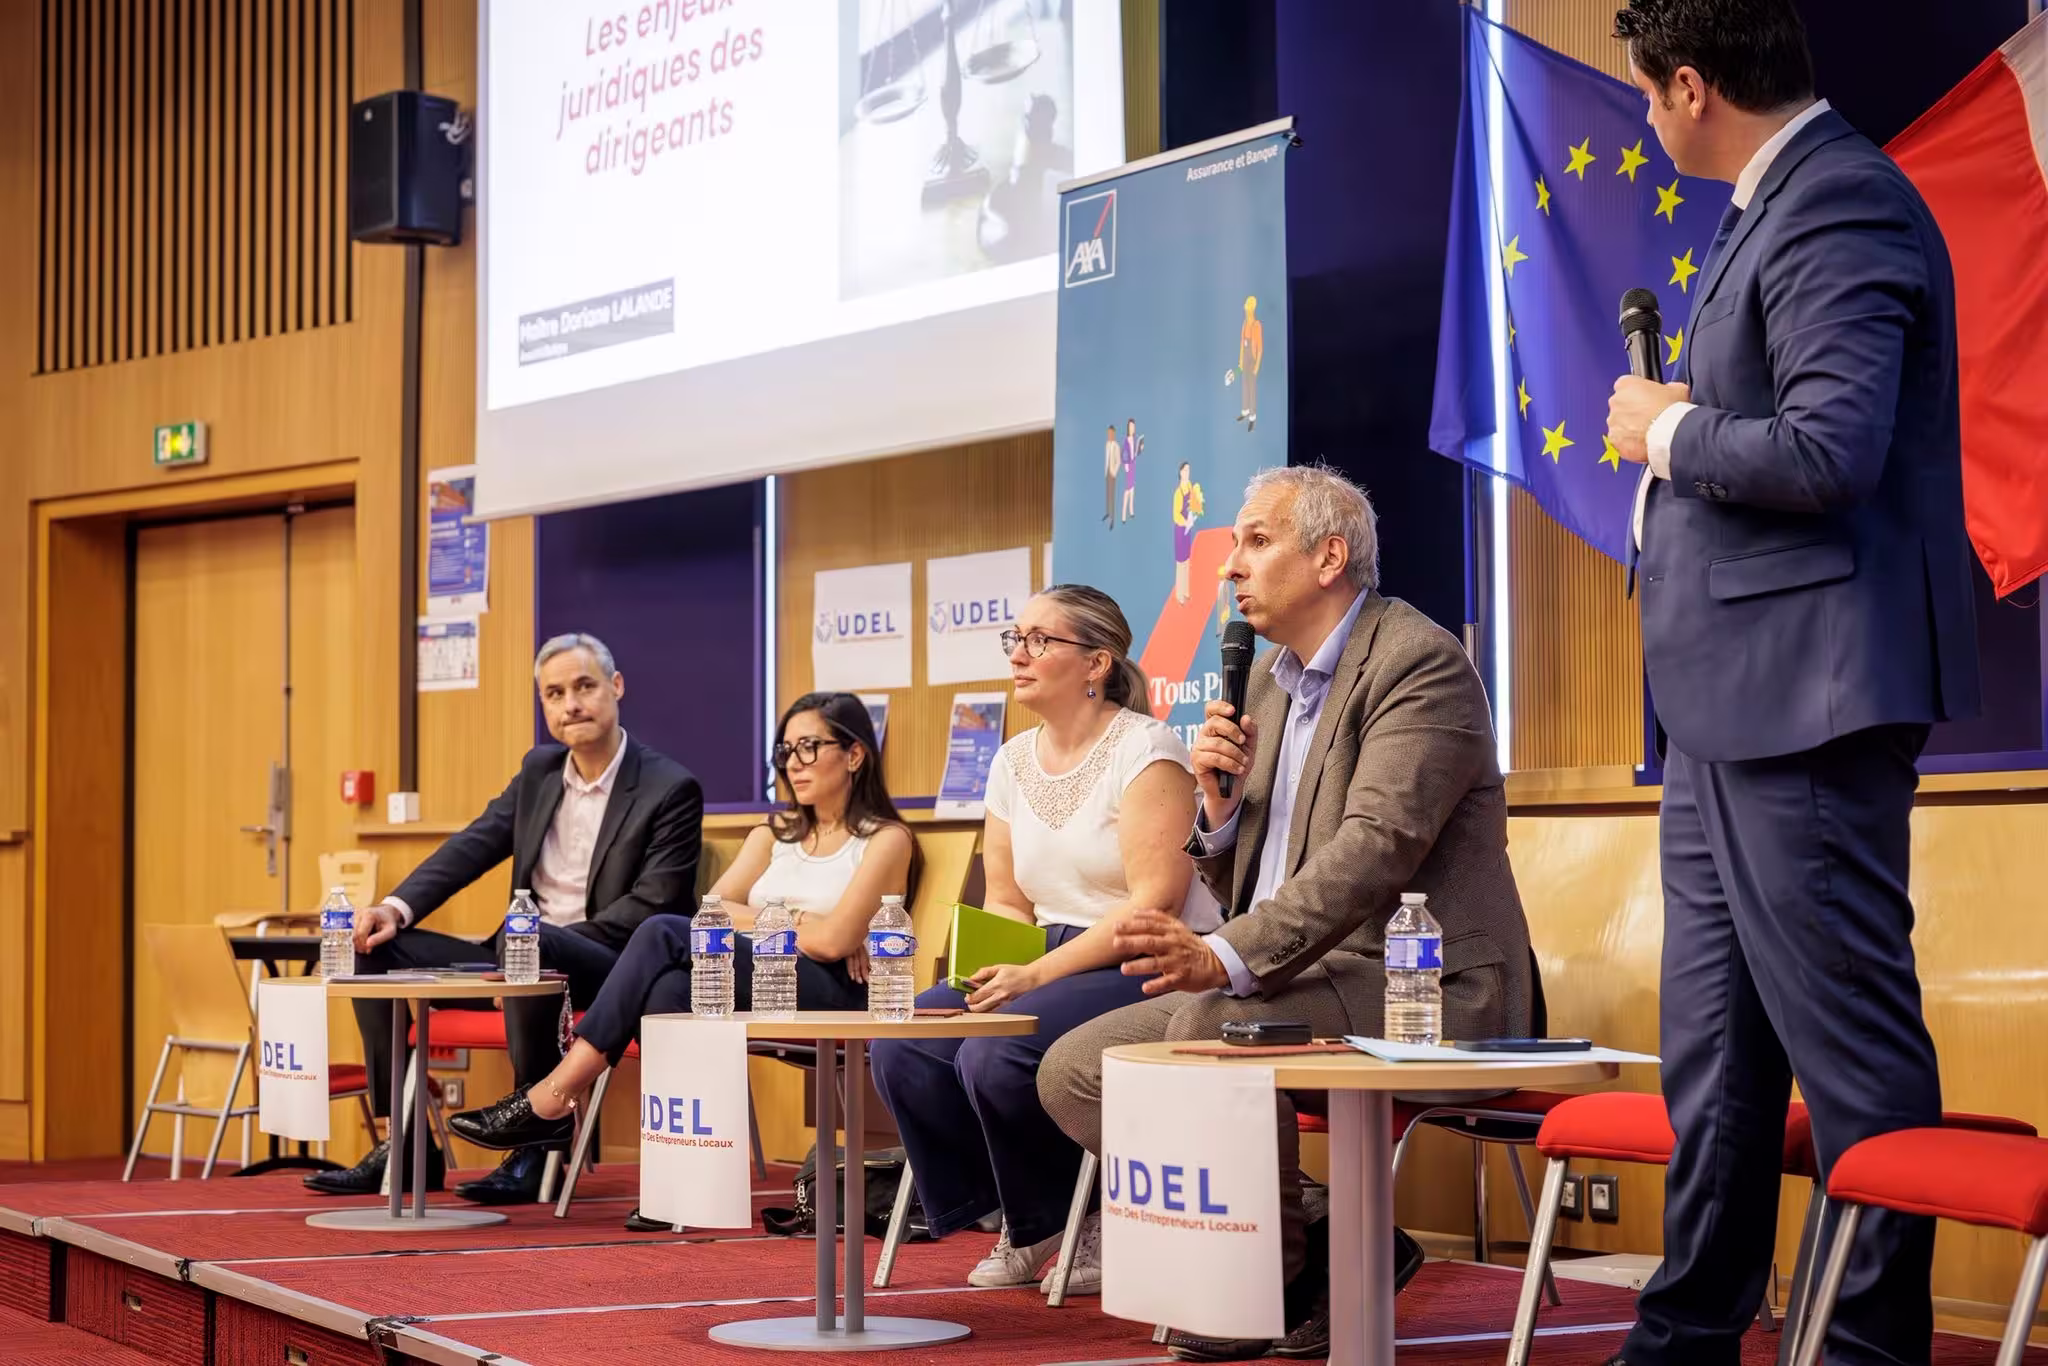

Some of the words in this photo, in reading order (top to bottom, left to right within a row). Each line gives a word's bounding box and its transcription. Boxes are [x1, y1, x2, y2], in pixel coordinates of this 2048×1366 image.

[585, 16, 627, 57] Les
[556, 48, 701, 141] juridiques
[710, 27, 763, 75] des
[585, 97, 734, 176] dirigeants
[1186, 158, 1234, 182] Assurance
[1235, 155, 1246, 169] et
[1246, 144, 1278, 163] Banque
[1066, 238, 1107, 277] AXA
[612, 286, 673, 322] LALANDE
[837, 611, 896, 636] UDEL
[952, 598, 1015, 626] UDEL
[1151, 676, 1200, 706] Tous
[259, 1040, 303, 1071] DEL
[656, 1134, 697, 1146] Entrepreneurs
[698, 1138, 734, 1148] Locaux
[1107, 1153, 1228, 1215] UDEL
[1124, 1207, 1138, 1220] Des
[1140, 1210, 1206, 1231] Entrepreneurs
[1208, 1220, 1259, 1233] Locaux
